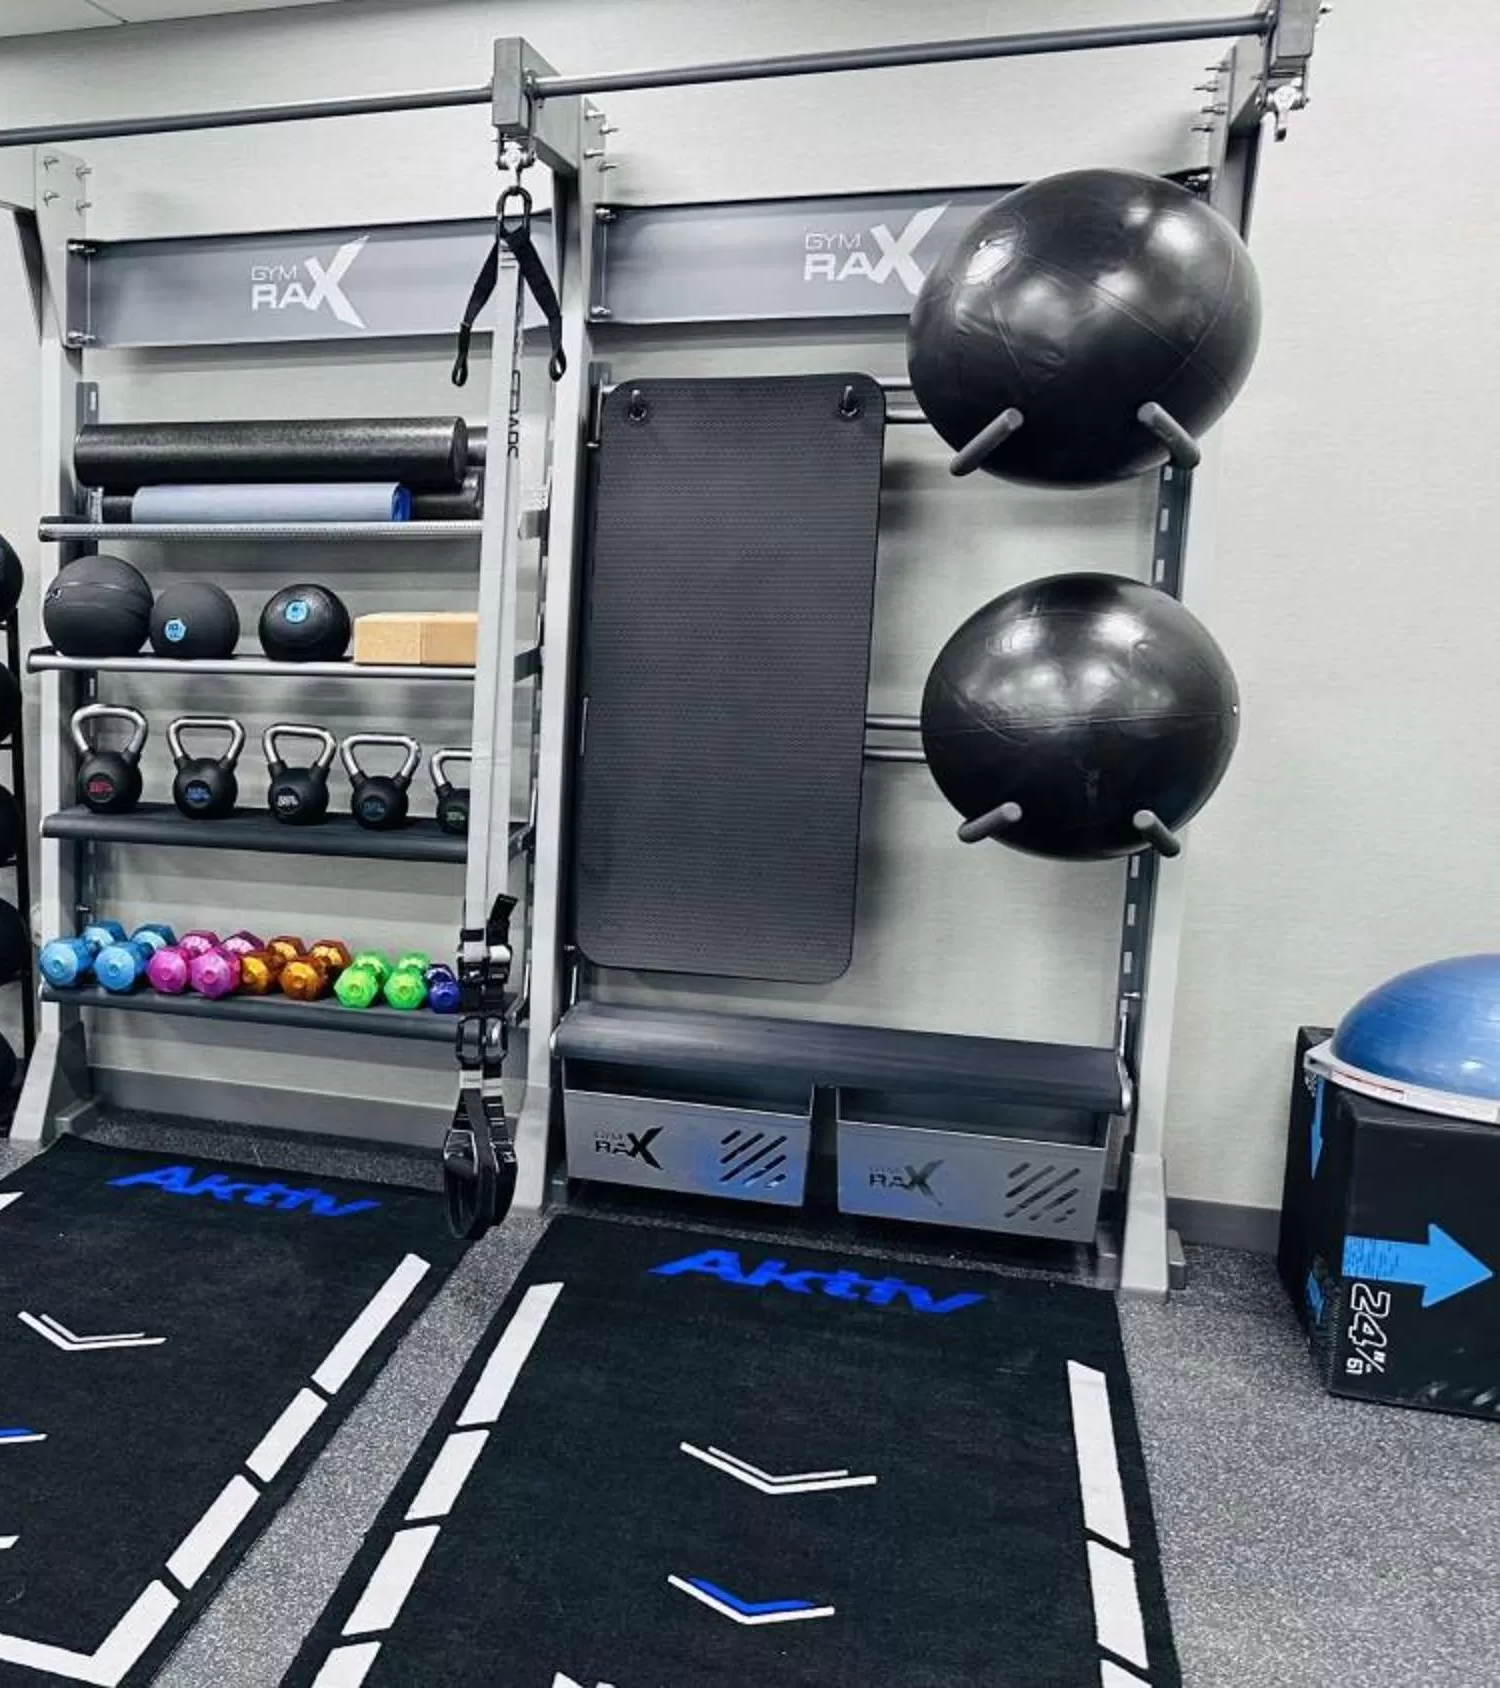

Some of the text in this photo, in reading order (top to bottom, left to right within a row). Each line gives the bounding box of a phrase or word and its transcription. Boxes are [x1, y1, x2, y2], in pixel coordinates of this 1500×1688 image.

[803, 199, 951, 297] RAX
[805, 231, 861, 249] GYM
[251, 264, 297, 280] GYM
[251, 235, 368, 329] RAX
[105, 1165, 382, 1216] Aktiv
[645, 1249, 989, 1313] Aktiv
